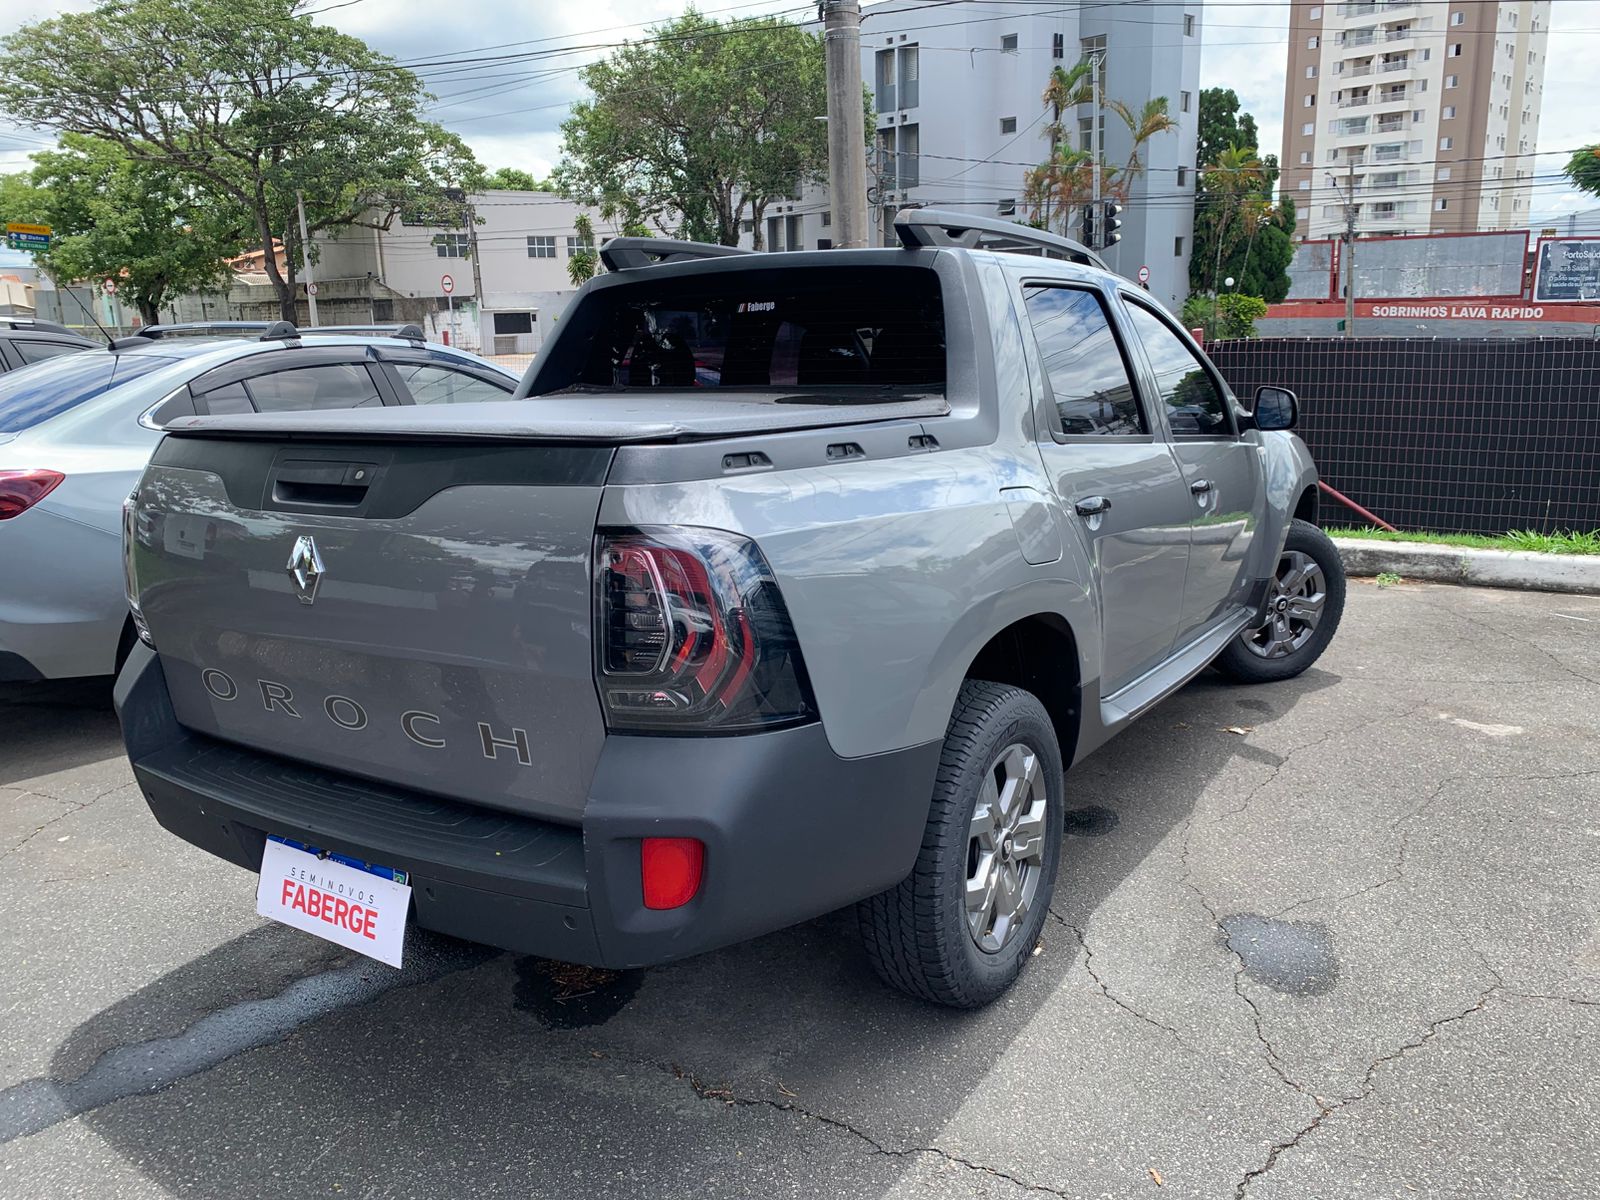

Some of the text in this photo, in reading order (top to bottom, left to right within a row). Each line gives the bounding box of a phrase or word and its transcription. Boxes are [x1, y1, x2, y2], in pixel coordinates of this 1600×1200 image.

[747, 301, 775, 311] Faberge
[1451, 307, 1487, 318] LAVA
[1491, 307, 1543, 319] RAPIDO
[201, 667, 533, 767] OROCH
[290, 866, 374, 904] SEMINOVOS
[281, 878, 379, 941] FABERGE
